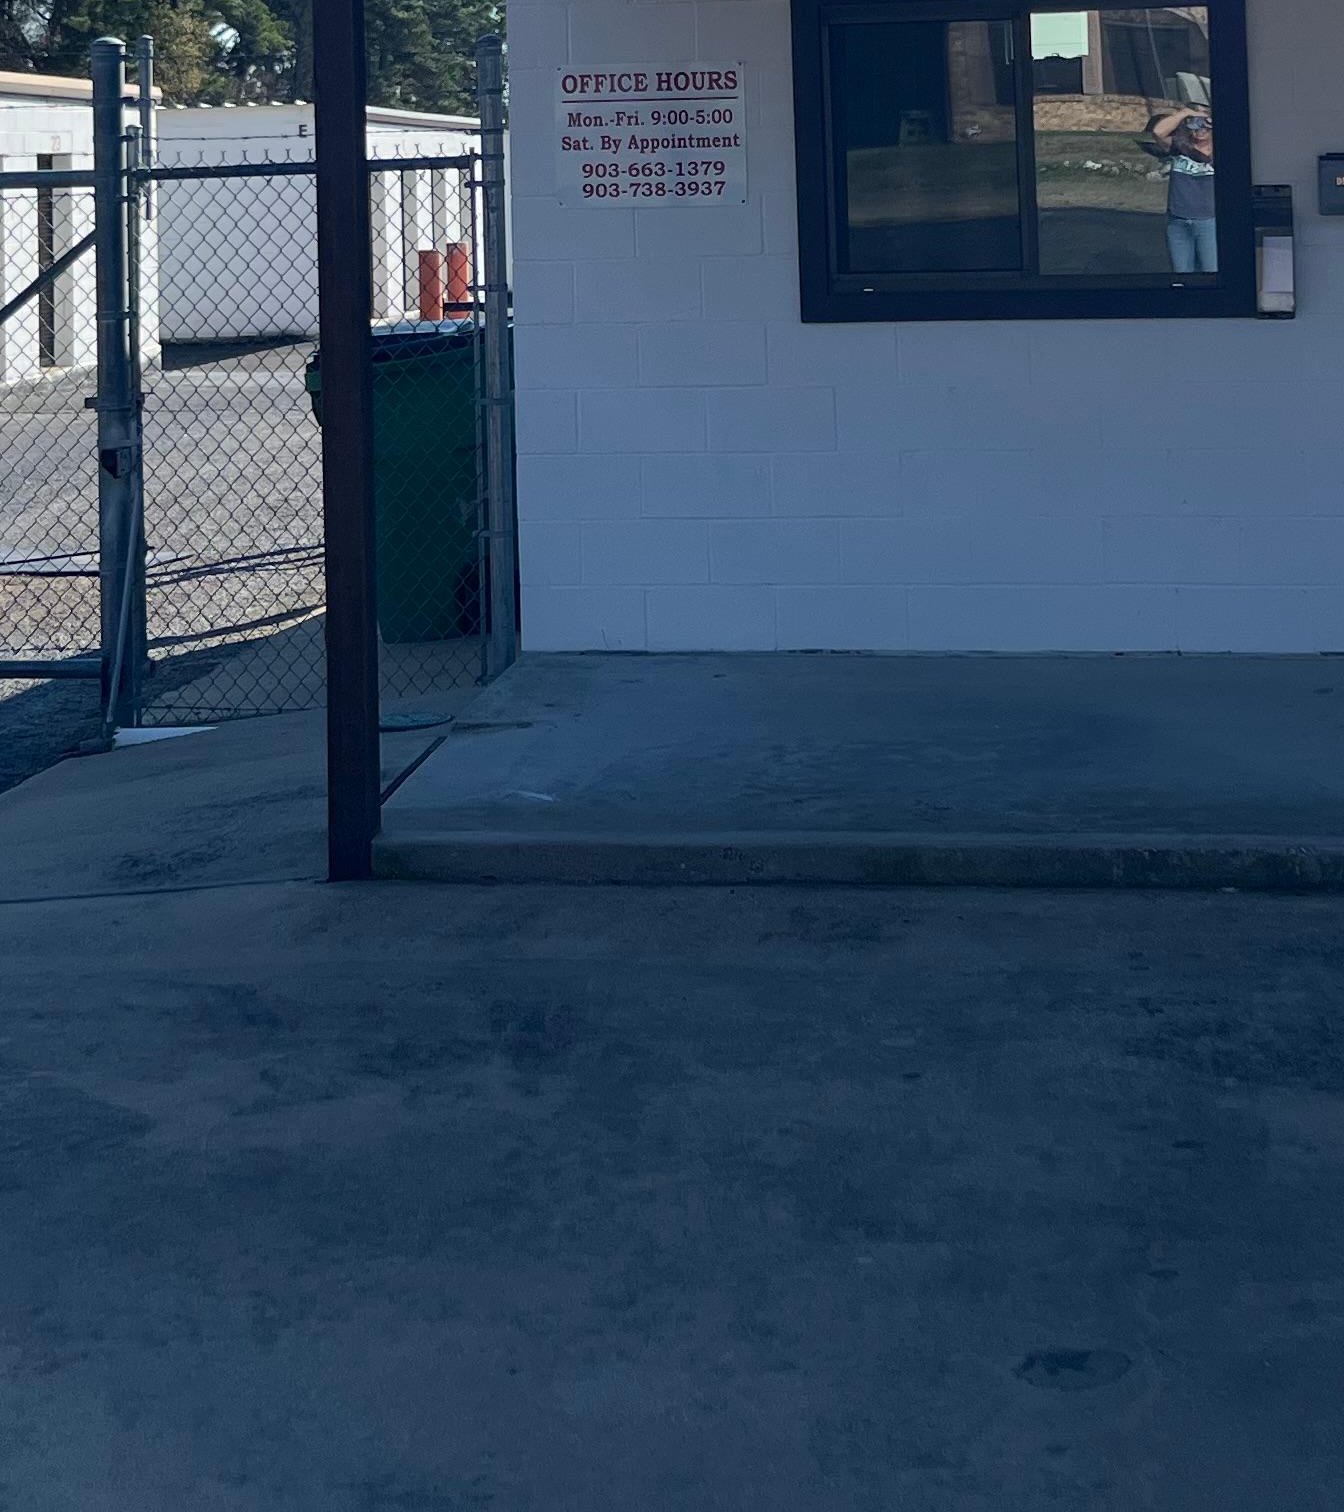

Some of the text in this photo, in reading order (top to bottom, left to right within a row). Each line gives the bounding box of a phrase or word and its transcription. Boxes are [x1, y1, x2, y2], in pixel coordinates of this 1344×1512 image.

[561, 71, 738, 94] OFFICE HOURS
[567, 109, 733, 127] Mon.-Fri. 9:00-5:00
[298, 124, 308, 138] E
[561, 133, 741, 154] Sat. By Appointment
[582, 161, 726, 178] 903-663-1379
[582, 181, 726, 198] 903-738-3937
